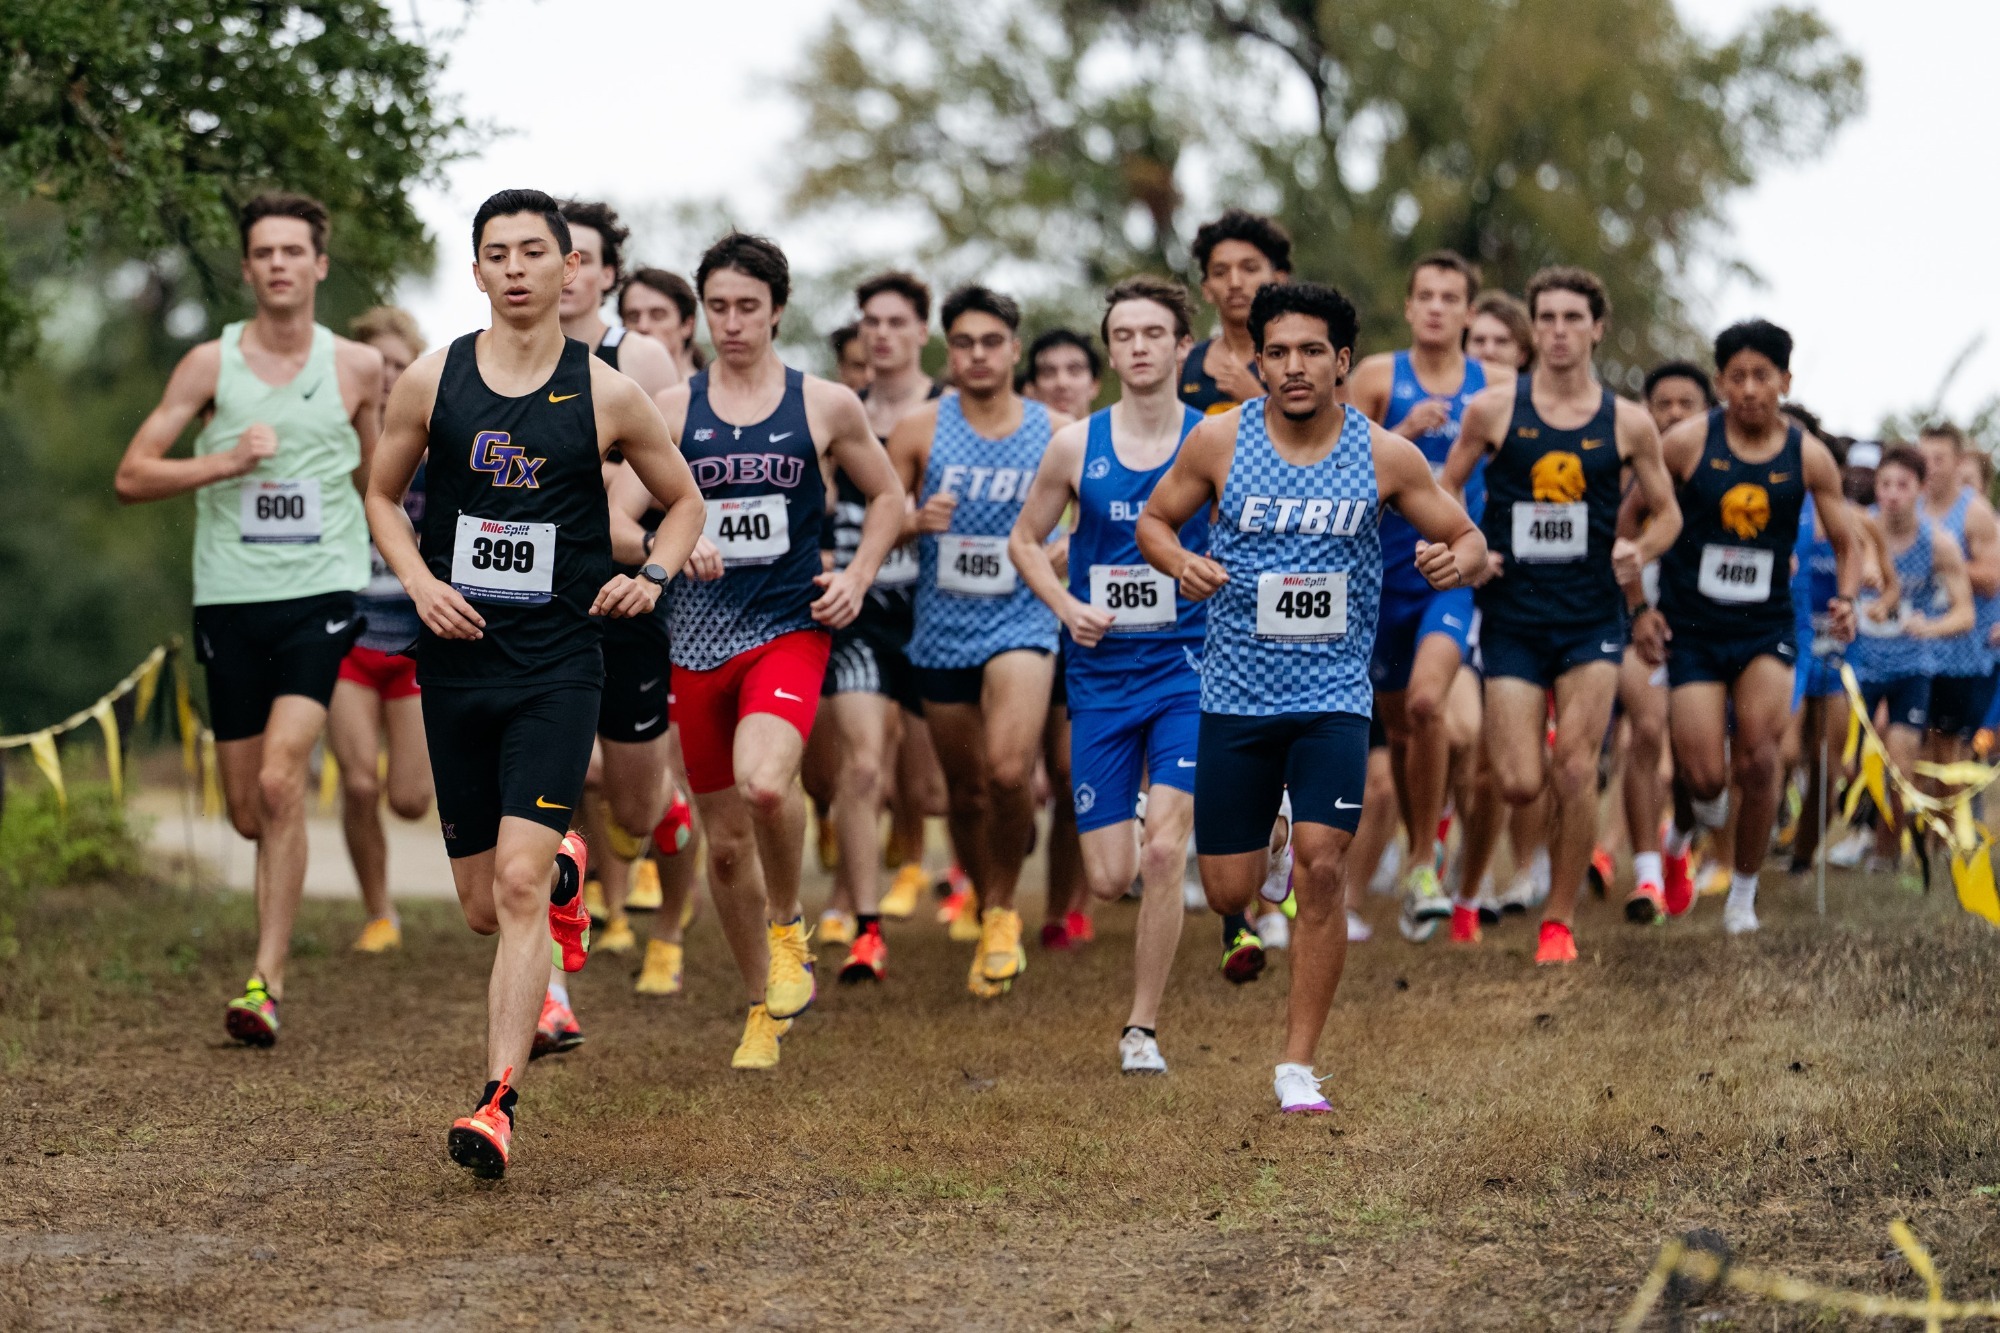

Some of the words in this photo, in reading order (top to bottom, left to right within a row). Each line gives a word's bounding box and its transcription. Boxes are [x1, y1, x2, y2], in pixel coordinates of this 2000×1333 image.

[689, 453, 805, 488] DBU
[256, 494, 304, 520] 600
[1239, 495, 1368, 537] ETBU
[480, 521, 530, 537] MileSplit
[718, 513, 770, 541] 440
[471, 536, 535, 573] 399
[1106, 581, 1158, 608] 365
[1283, 576, 1326, 587] MileSplit
[1275, 590, 1332, 619] 493
